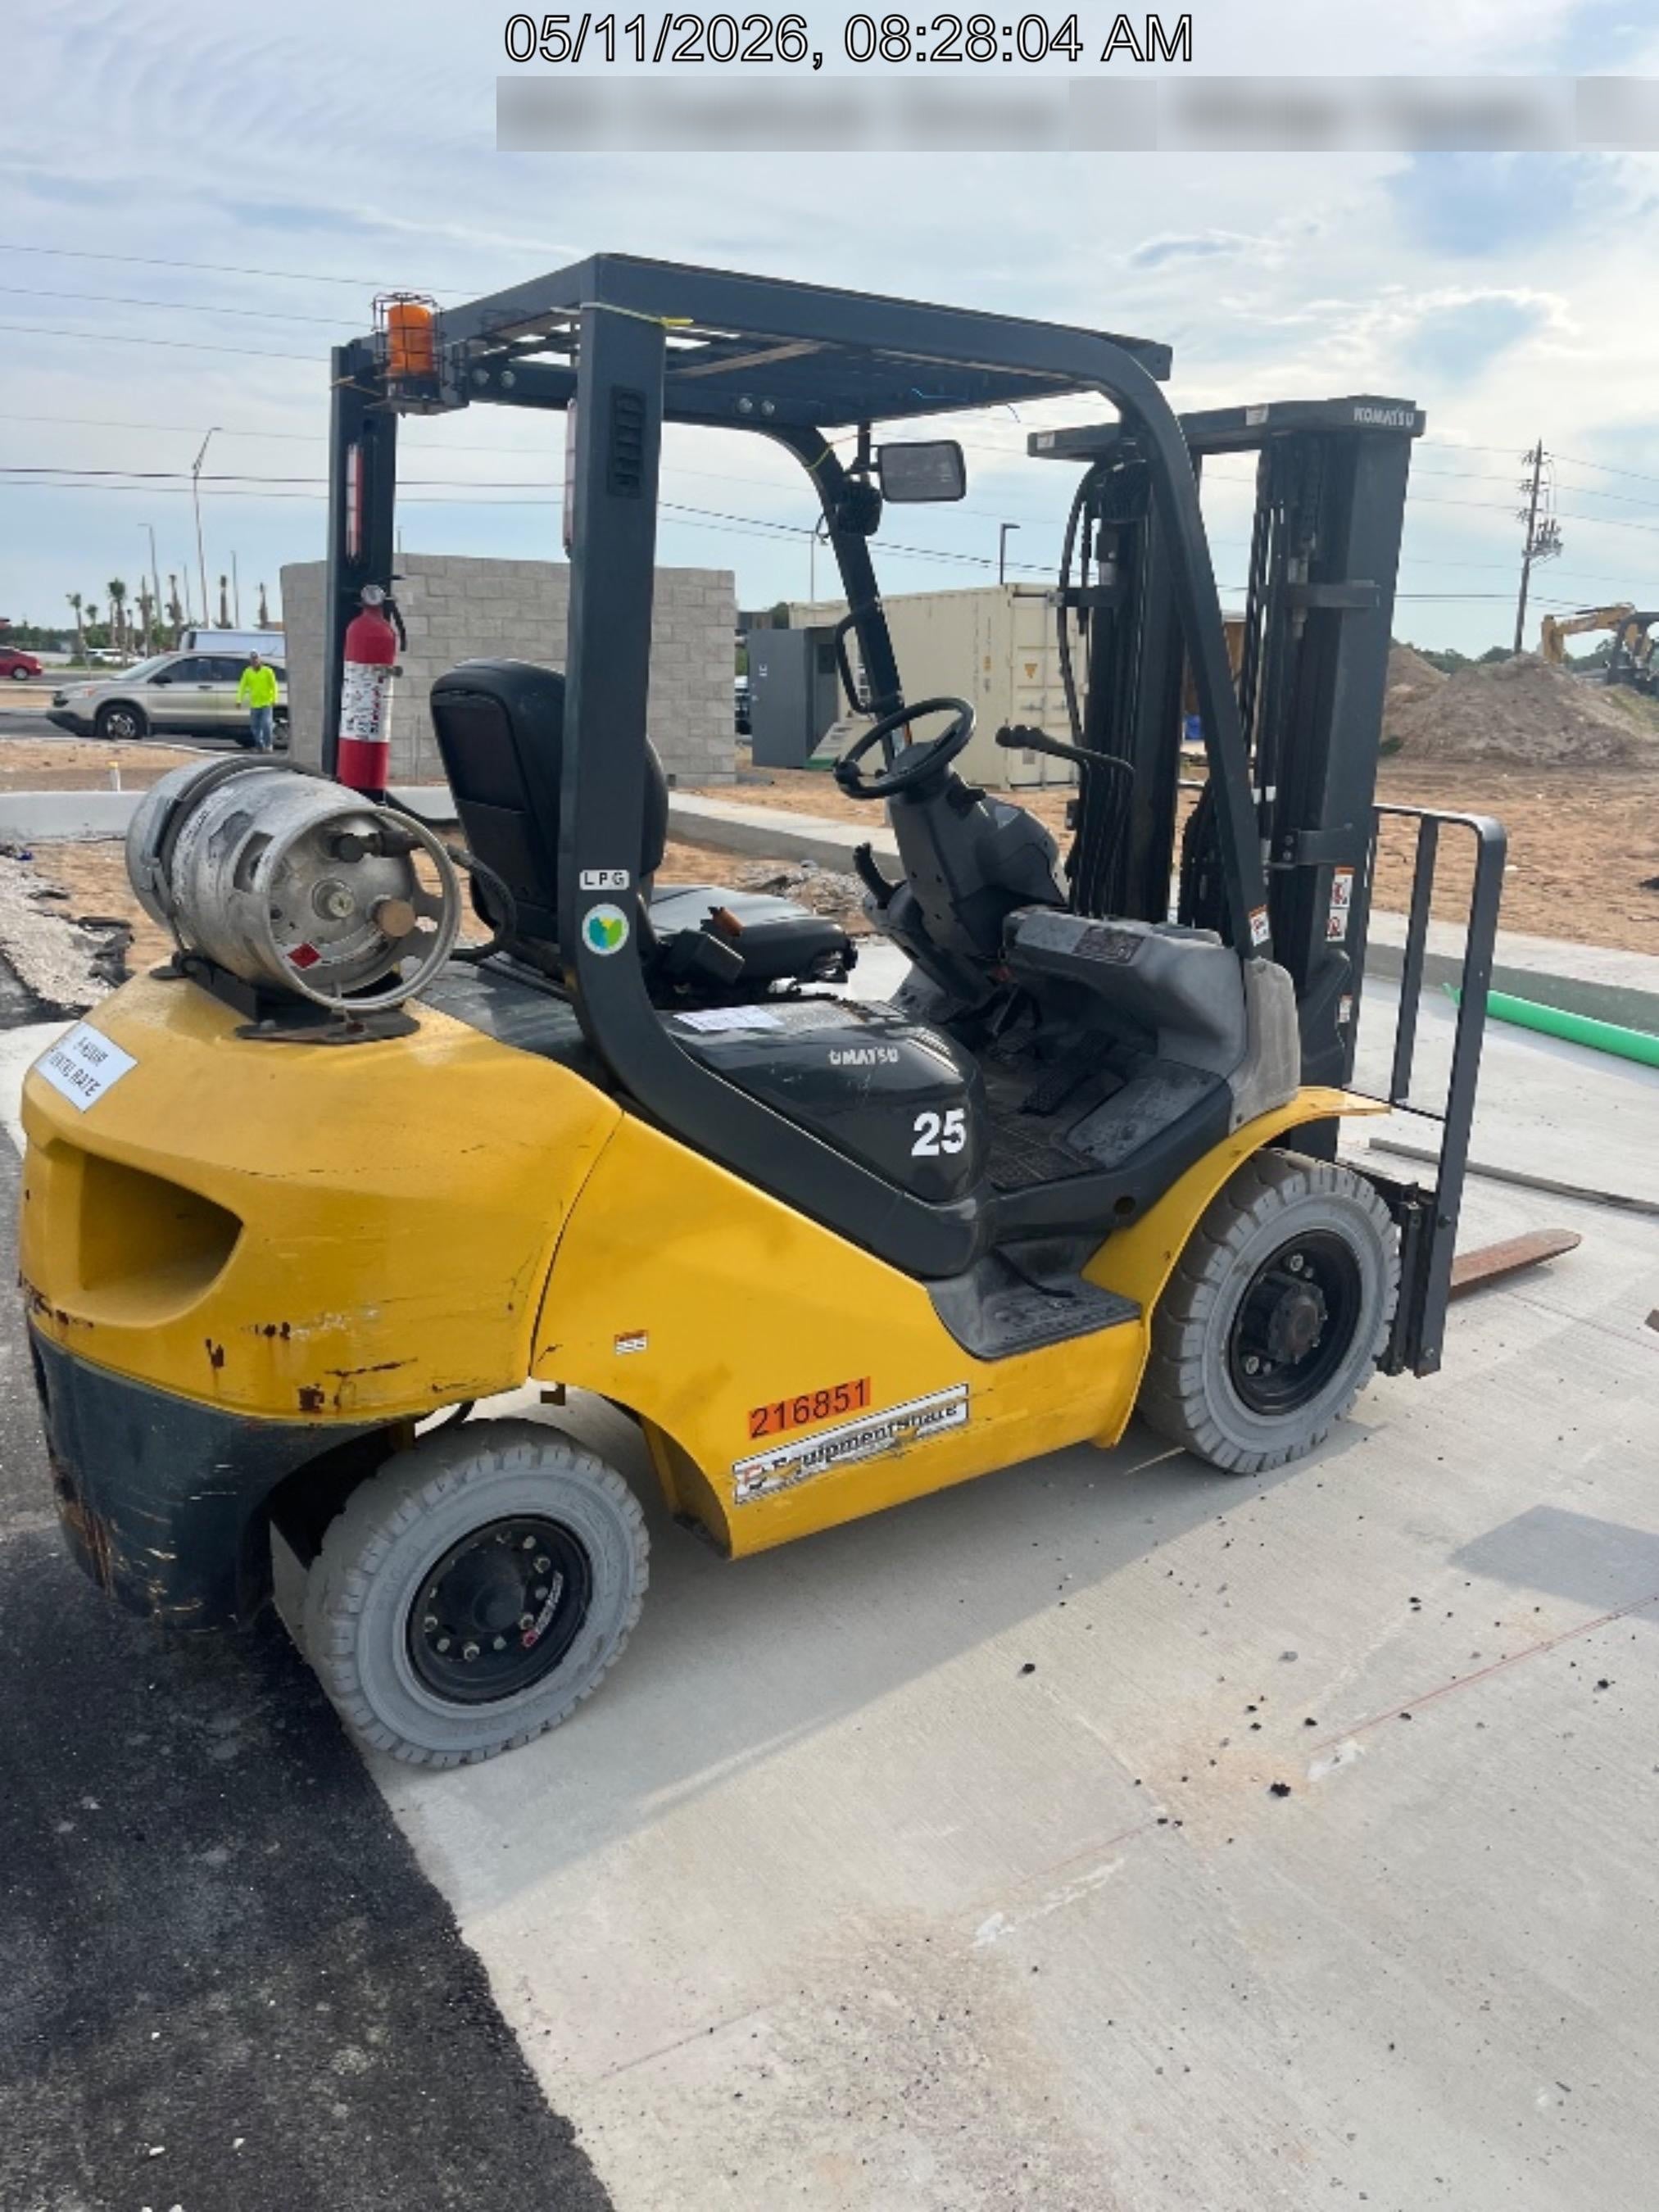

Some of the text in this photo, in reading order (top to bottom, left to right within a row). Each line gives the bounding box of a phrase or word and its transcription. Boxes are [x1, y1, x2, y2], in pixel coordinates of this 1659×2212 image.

[1353, 407, 1415, 426] KOMATSU
[584, 872, 624, 886] LPG
[911, 1108, 966, 1157] 25
[750, 1379, 866, 1439] 216851
